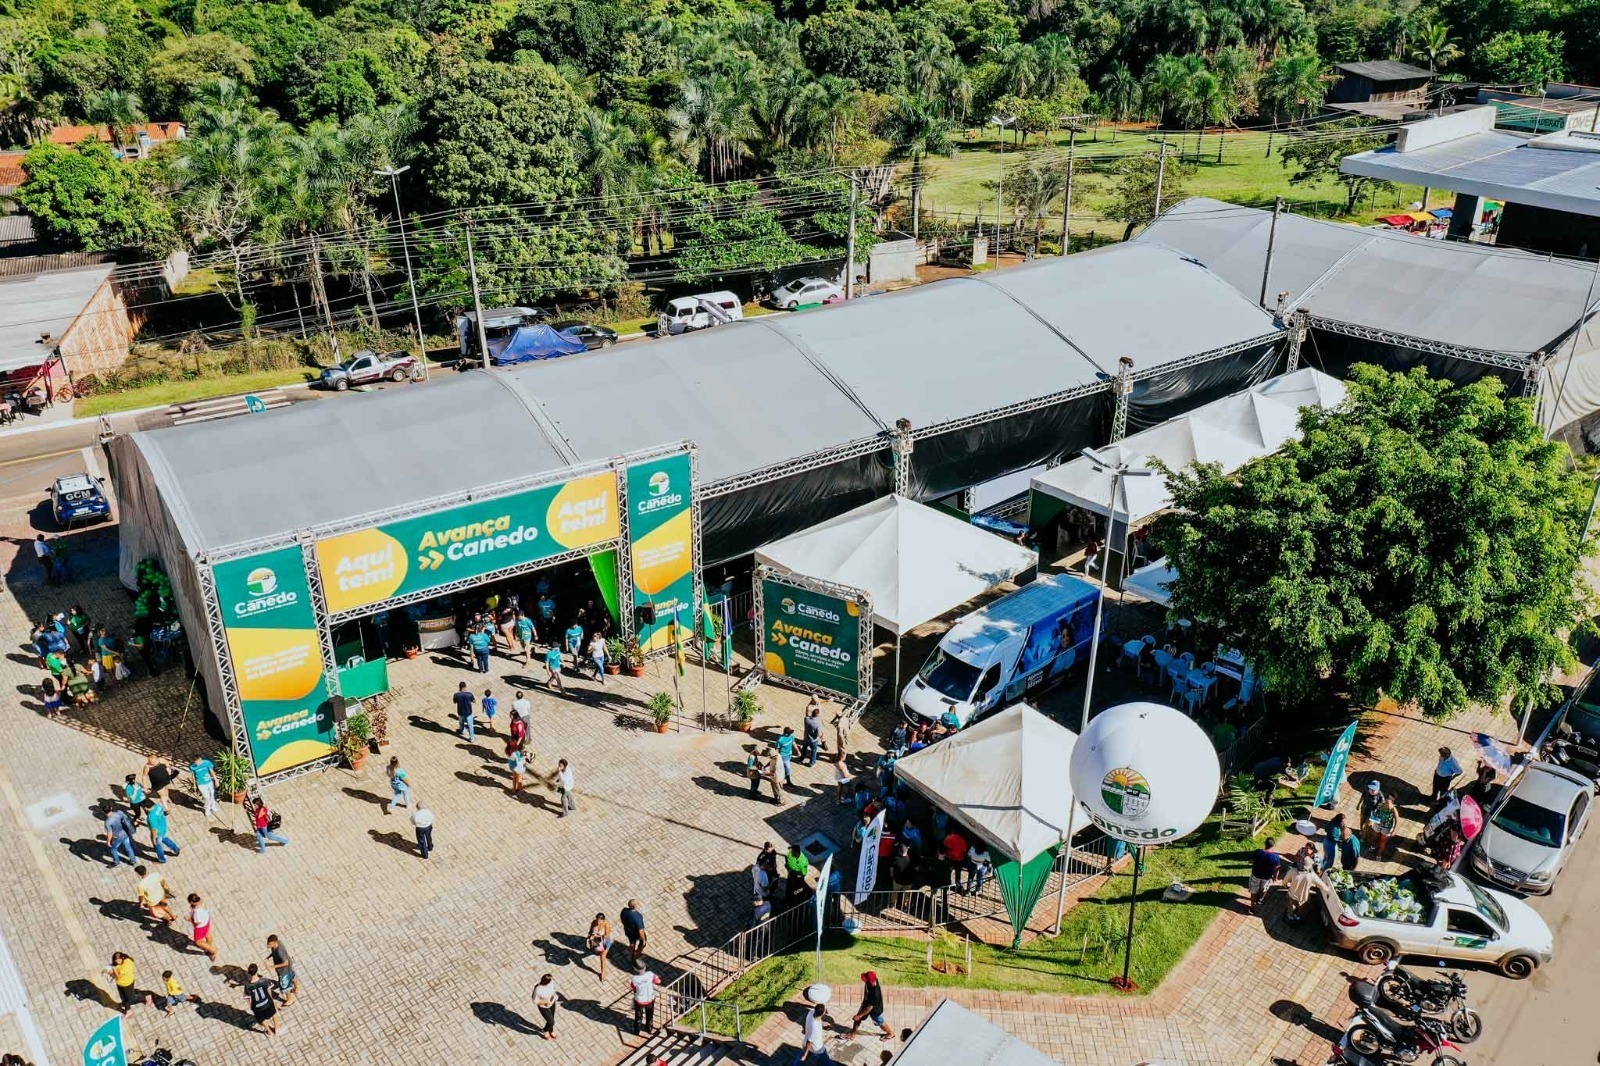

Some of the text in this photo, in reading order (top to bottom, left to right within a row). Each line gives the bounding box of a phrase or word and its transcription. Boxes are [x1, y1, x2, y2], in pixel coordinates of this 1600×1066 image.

[65, 489, 91, 501] GCM
[558, 490, 607, 519] Aqui
[637, 493, 682, 512] Canedo
[418, 515, 511, 551] Avança
[561, 509, 607, 534] tem!
[447, 525, 538, 561] Canedo
[335, 542, 392, 575] Aqui
[338, 562, 394, 592] tem!
[234, 591, 297, 615] Canedo
[797, 603, 840, 622] Canedo
[772, 619, 833, 645] Avança
[789, 635, 851, 662] Canedo
[256, 709, 309, 731] Avança
[272, 713, 325, 734] Canedo
[1323, 753, 1344, 797] Canedo
[864, 844, 876, 891] Canedo
